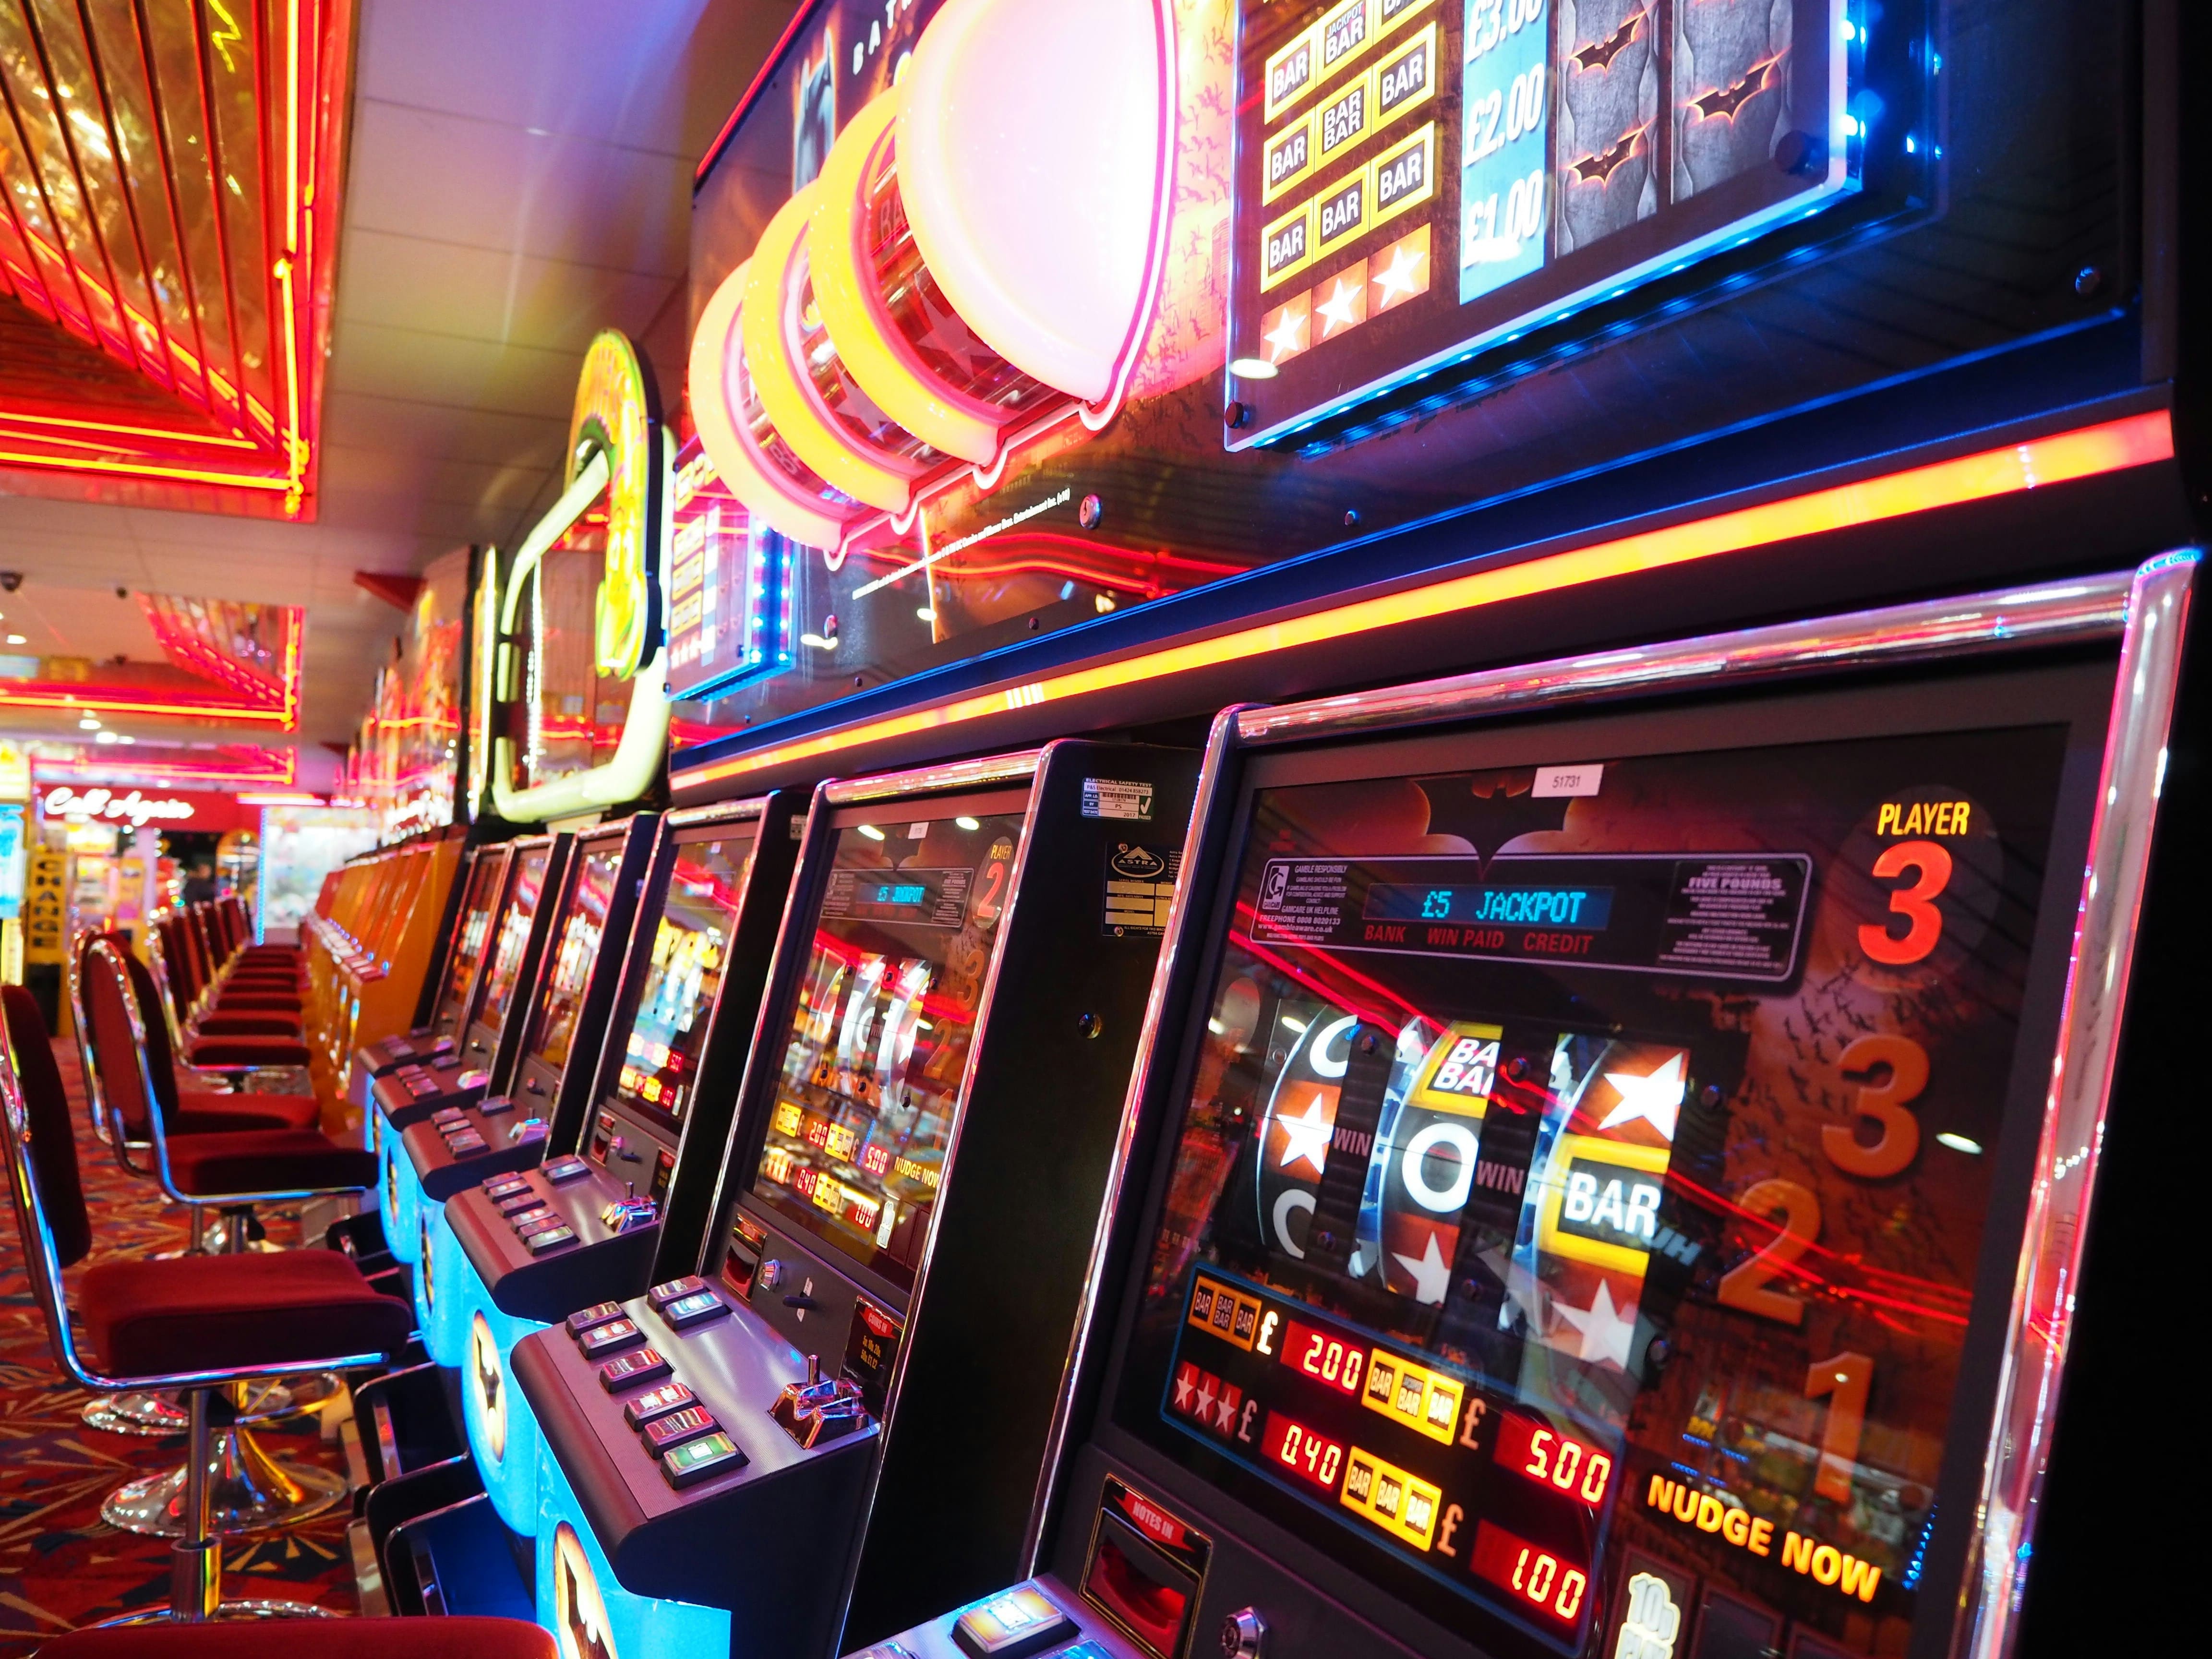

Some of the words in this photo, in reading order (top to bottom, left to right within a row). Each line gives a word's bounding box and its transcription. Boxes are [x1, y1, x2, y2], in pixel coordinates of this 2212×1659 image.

[1327, 2, 1363, 38] JACKPOT
[1273, 49, 1308, 98] BAR
[1325, 17, 1363, 64] BAR
[1271, 135, 1306, 182] BAR
[1324, 90, 1361, 130] BAR
[1381, 53, 1424, 106] BAR
[1465, 61, 1544, 168] £2.00
[1323, 115, 1360, 152] BAR
[1269, 225, 1304, 269] BAR
[1322, 191, 1359, 237] BAR
[1380, 152, 1421, 202] BAR
[1464, 168, 1544, 269] £1.00
[1552, 775, 1581, 788] 51731
[1877, 801, 1970, 836] PLAYER
[990, 844, 1012, 859] PLAYER
[977, 862, 1004, 918] 2
[1422, 891, 1452, 918] £5
[1476, 891, 1586, 923] JACKPOT
[1688, 877, 1719, 888] FIVE
[1720, 878, 1782, 889] POUNDS
[1858, 841, 1952, 964] 3
[1258, 923, 1333, 933] www.gambleaware.co.uk
[1260, 914, 1296, 923] FREEPHONE
[1313, 907, 1339, 915] HELPLINE
[1364, 925, 1406, 943] BANK
[1427, 927, 1458, 946] WIN
[1463, 929, 1505, 949] PAID
[1524, 933, 1593, 954] CREDIT
[957, 950, 985, 1011] 3
[923, 1018, 952, 1080] 2
[1448, 1039, 1501, 1068] BA
[937, 1089, 953, 1150] 1
[1822, 1034, 1929, 1177] 3
[894, 1156, 922, 1181] NUDGE
[1333, 1127, 1372, 1157] WIN
[1477, 1159, 1525, 1195] WIN
[1565, 1172, 1662, 1238] BAR
[1718, 1179, 1821, 1326] 2
[1195, 1291, 1211, 1315] BAR
[1217, 1296, 1233, 1314] BAR
[1236, 1310, 1254, 1334] BAR
[1256, 1311, 1279, 1356] £
[1214, 1310, 1230, 1329] BAR
[1238, 1399, 1257, 1442] £
[1370, 1368, 1393, 1397] BAR
[1428, 1392, 1454, 1425] BAR
[1460, 1398, 1487, 1450] £
[1396, 1387, 1421, 1416] BAR
[1804, 1351, 1872, 1503] 1
[1133, 1501, 1162, 1531] NOTES
[1161, 1521, 1174, 1539] IN
[1348, 1466, 1371, 1497] BAR
[1376, 1479, 1401, 1514] BAR
[1406, 1495, 1431, 1530] BAR
[1437, 1503, 1464, 1557] £
[1647, 1475, 1775, 1557] NUDGE
[1781, 1531, 1881, 1604] NOW
